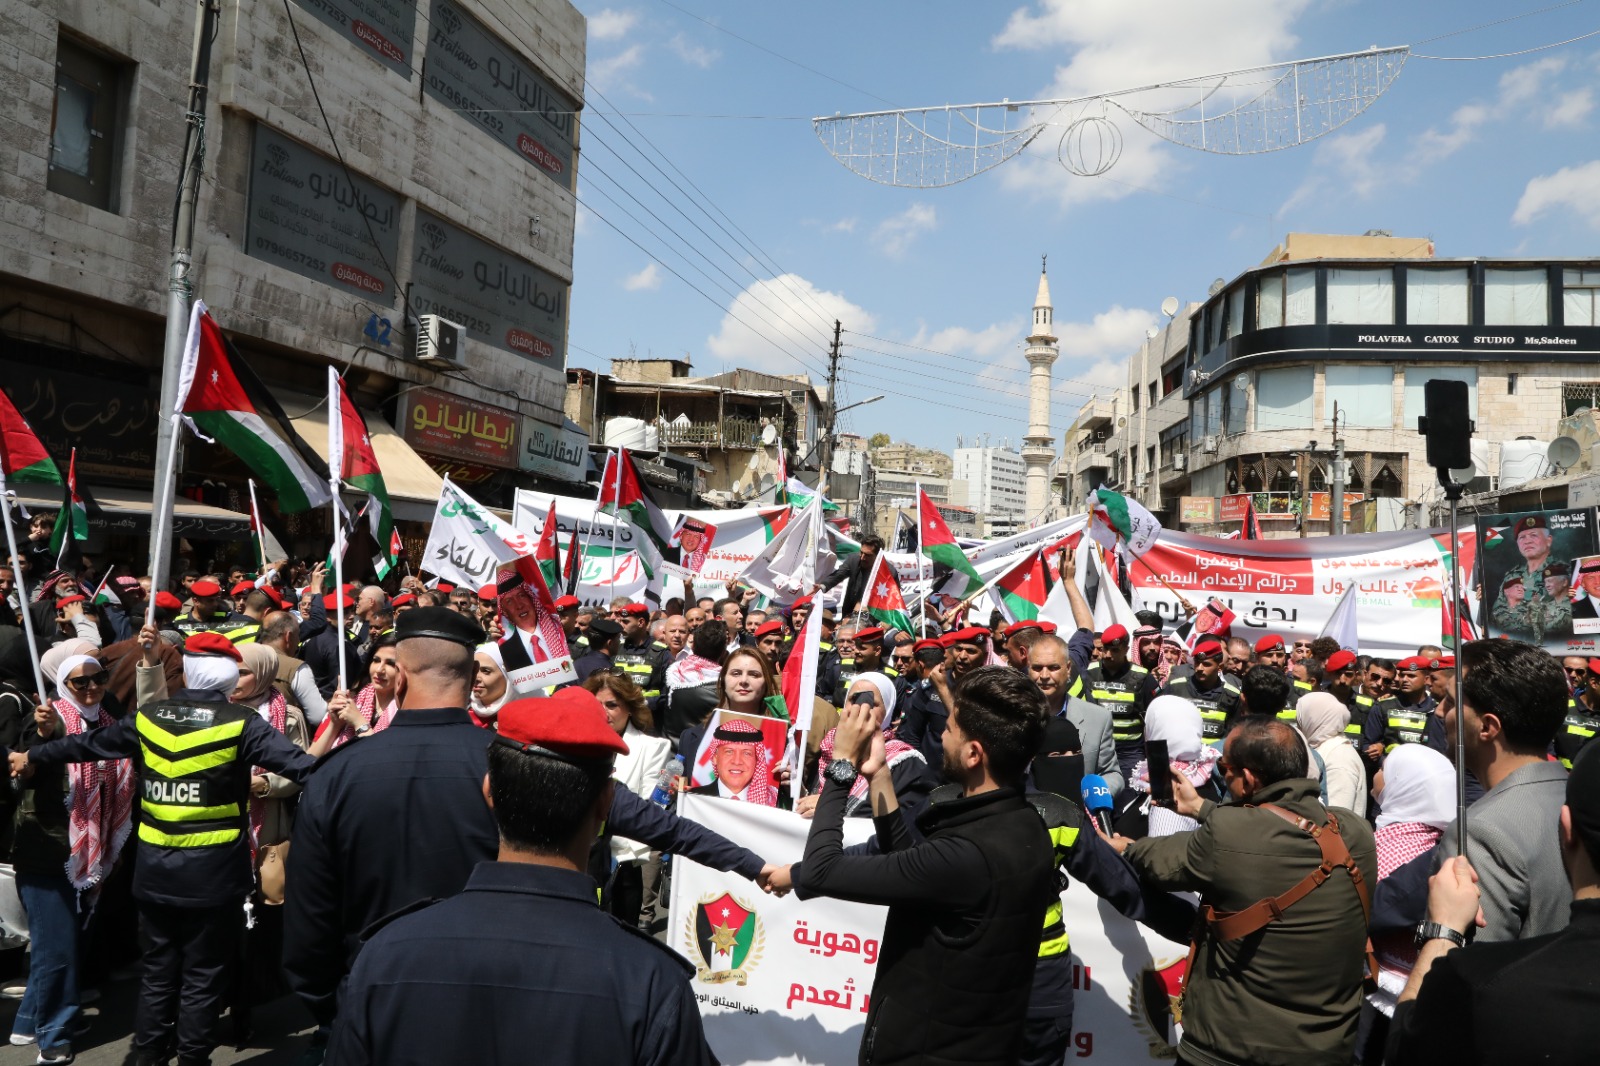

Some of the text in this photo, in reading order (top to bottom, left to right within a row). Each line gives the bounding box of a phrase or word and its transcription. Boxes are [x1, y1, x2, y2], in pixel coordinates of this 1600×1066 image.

[430, 75, 504, 134] 0796657252
[256, 236, 326, 272] 0796657252
[364, 314, 391, 346] 42
[1358, 335, 1412, 343] POLAVERA
[1424, 335, 1460, 344] CATOX
[1474, 336, 1515, 345] STUDIO
[1202, 573, 1252, 590] الإعدام
[1256, 574, 1297, 592] جرائم
[1322, 578, 1399, 596] غالب ول
[1370, 598, 1393, 606] MALL
[1243, 600, 1298, 628] بحق
[157, 706, 215, 722] الشرطة
[1203, 724, 1219, 734] LICE
[145, 780, 200, 802] POLICE
[793, 919, 879, 965] وهوية
[694, 993, 758, 1015] حزب الميثاق الو
